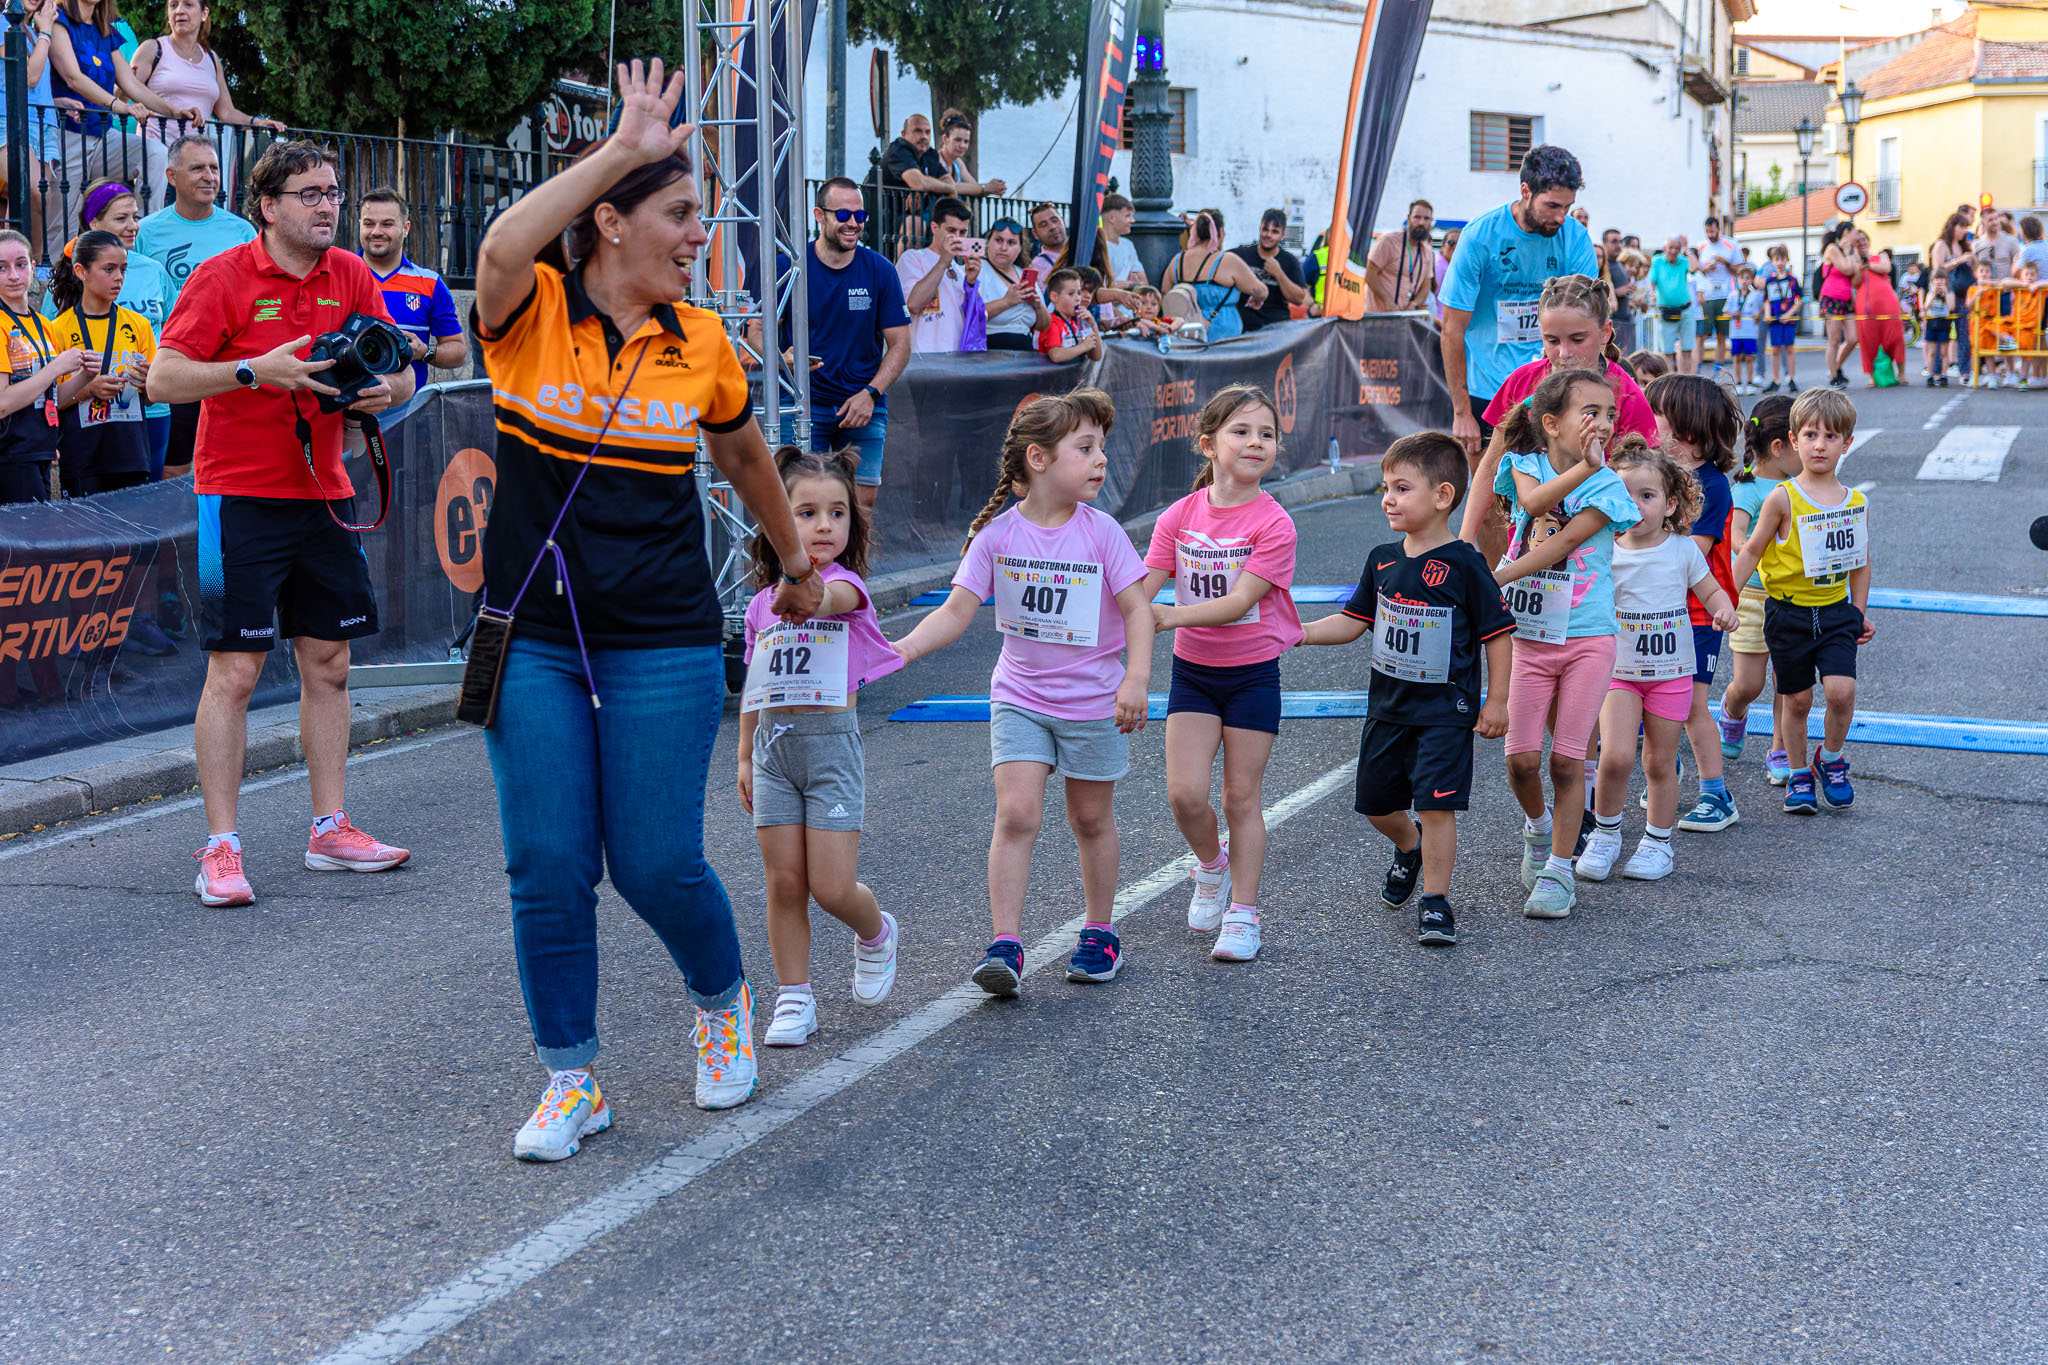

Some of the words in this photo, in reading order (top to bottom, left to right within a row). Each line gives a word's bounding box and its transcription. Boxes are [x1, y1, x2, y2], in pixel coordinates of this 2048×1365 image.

[1517, 313, 1539, 329] 172
[538, 383, 585, 416] e3
[1807, 514, 1825, 523] LEGUA
[1825, 528, 1855, 551] 405
[1190, 548, 1228, 559] NOCTURNA
[1229, 547, 1252, 557] UGENA
[1004, 557, 1027, 568] LEGUA
[1028, 560, 1071, 572] NOCTURNA
[1072, 562, 1098, 574] UGENA
[1190, 572, 1228, 599] 419
[1547, 572, 1570, 581] UGENA
[1021, 585, 1068, 615] 407
[1504, 586, 1544, 615] 408
[1389, 603, 1424, 617] NOCTURNA
[1425, 608, 1448, 618] UGENA
[1621, 610, 1640, 620] LEGUA
[1641, 610, 1674, 620] NOCTURNA
[816, 621, 844, 633] UGENA
[1384, 626, 1421, 655] 401
[1636, 631, 1677, 656] 400
[768, 646, 812, 676] 412
[1706, 654, 1717, 673] 10
